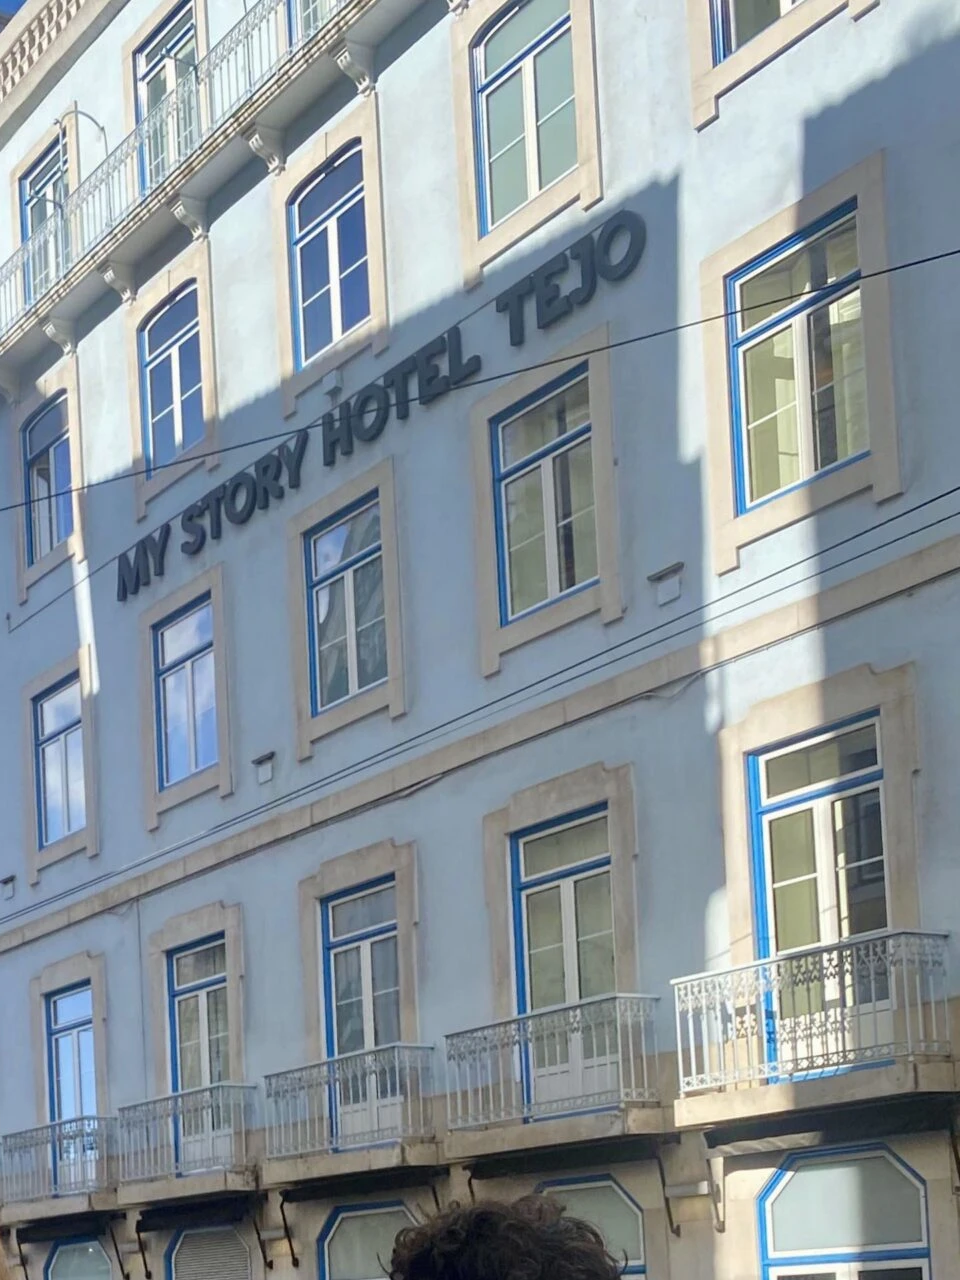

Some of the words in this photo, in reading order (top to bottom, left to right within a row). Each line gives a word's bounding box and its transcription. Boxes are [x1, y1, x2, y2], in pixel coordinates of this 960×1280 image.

[117, 522, 171, 602] MY
[180, 429, 310, 556] STORY
[321, 325, 482, 467] HOTEL
[495, 209, 647, 347] TEJO
